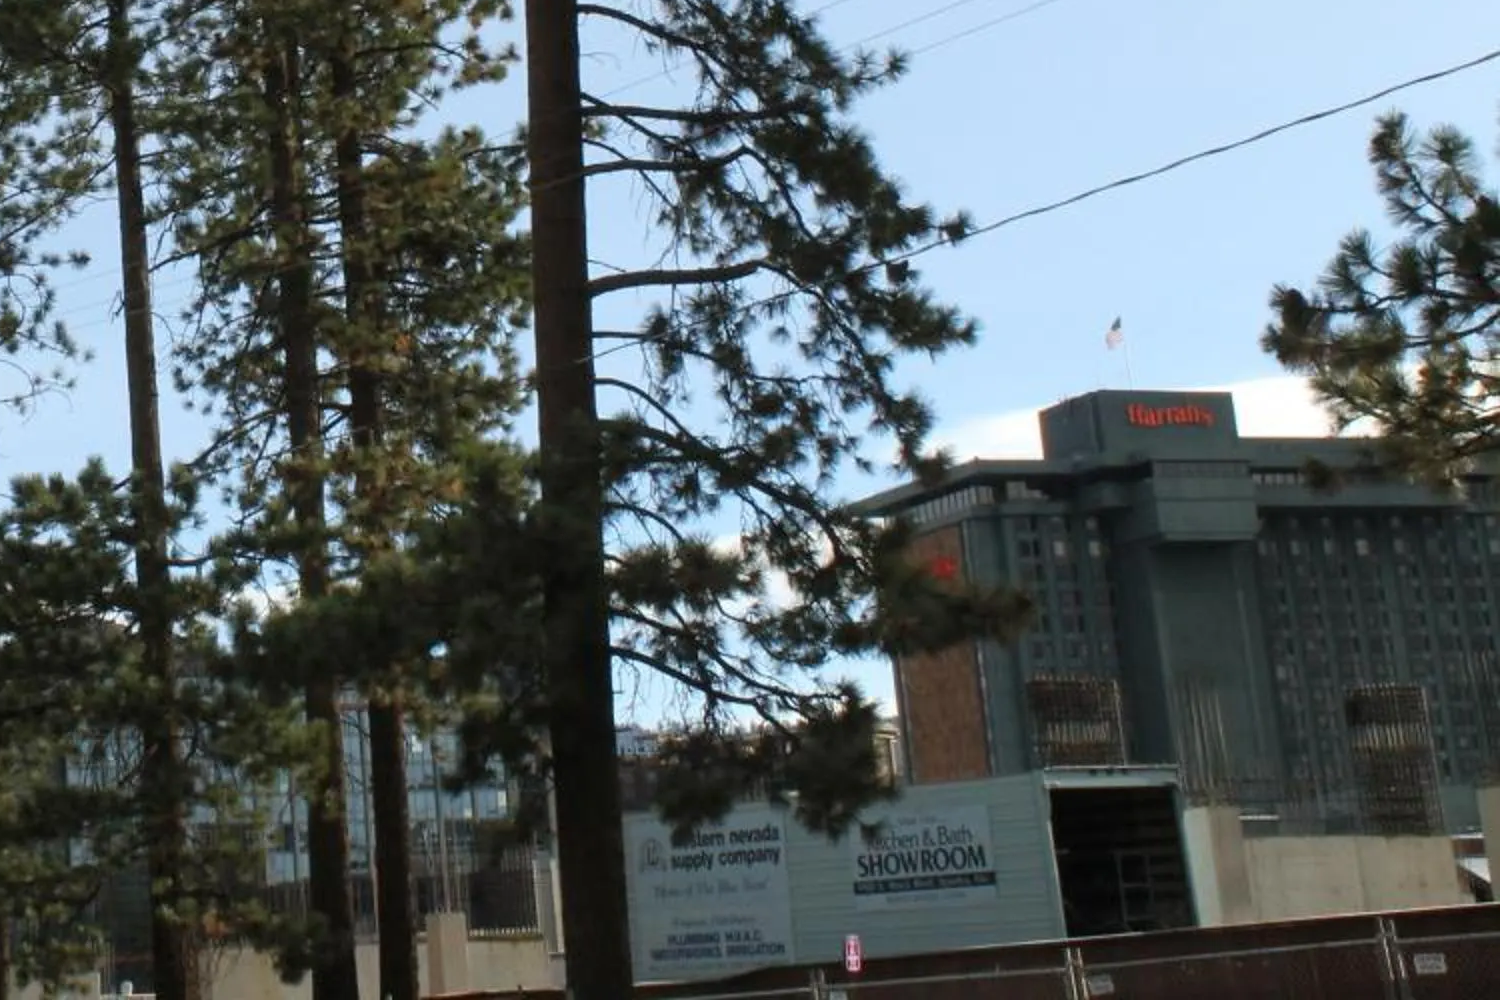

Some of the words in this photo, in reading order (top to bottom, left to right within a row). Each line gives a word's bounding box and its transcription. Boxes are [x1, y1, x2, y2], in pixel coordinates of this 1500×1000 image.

[729, 823, 779, 844] nevada
[671, 850, 714, 871] supply
[718, 847, 781, 868] company
[857, 844, 987, 877] SHOWROOM
